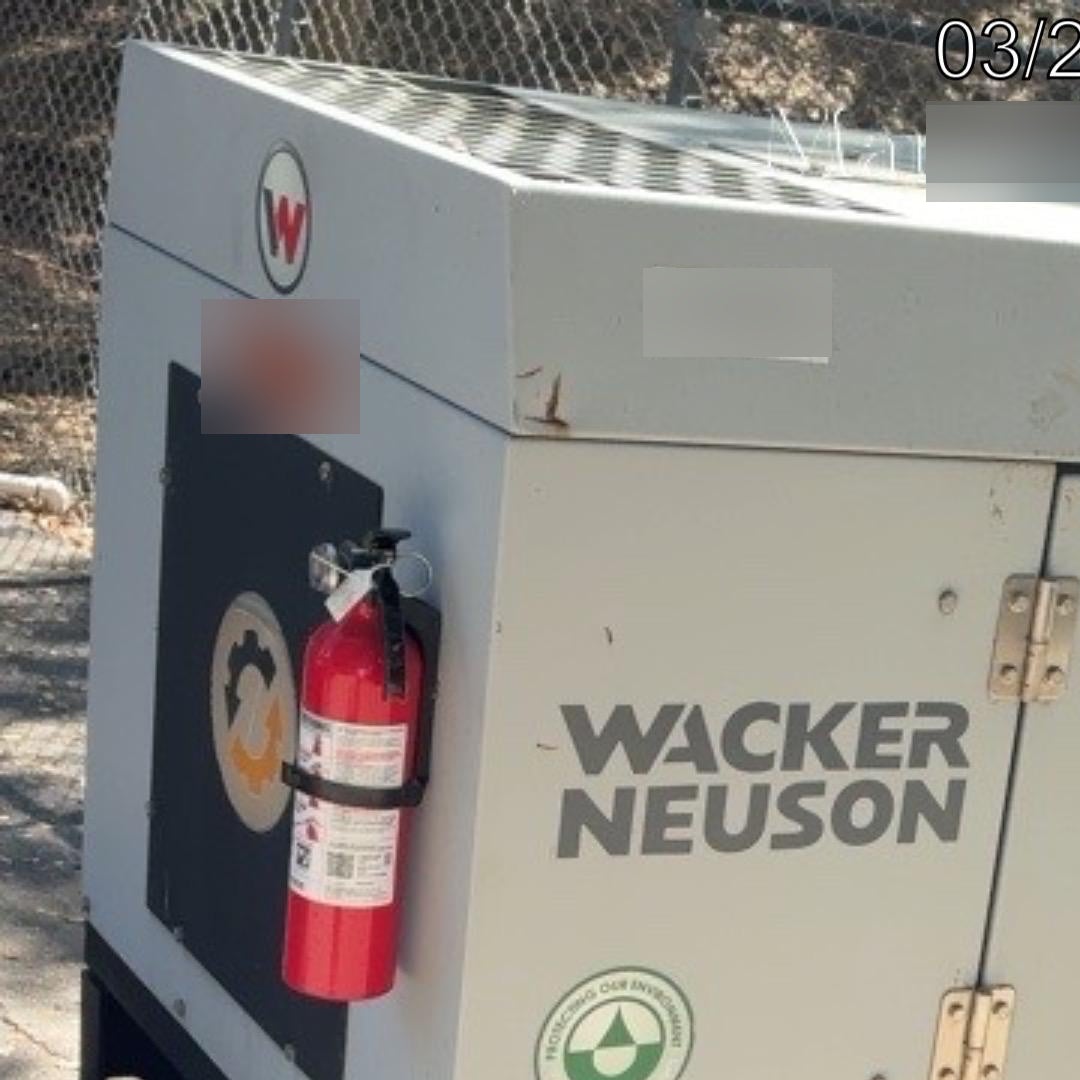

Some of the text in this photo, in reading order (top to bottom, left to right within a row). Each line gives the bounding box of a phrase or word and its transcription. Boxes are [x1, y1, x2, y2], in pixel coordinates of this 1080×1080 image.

[559, 701, 970, 775] WACKER
[557, 779, 967, 858] NEUSON
[600, 979, 628, 994] OUR
